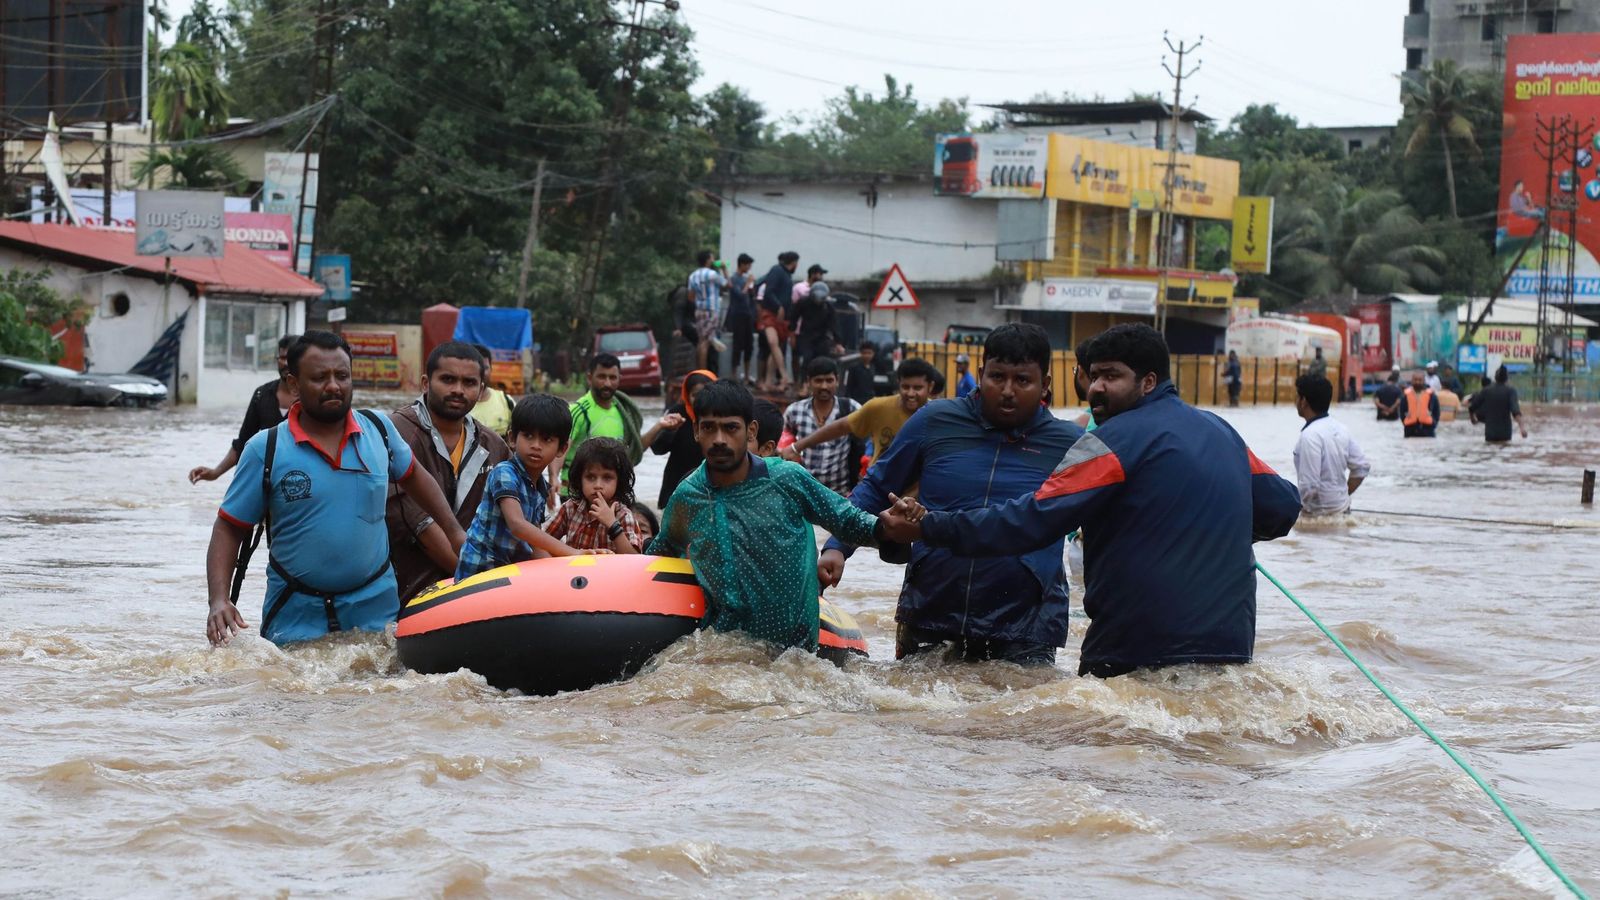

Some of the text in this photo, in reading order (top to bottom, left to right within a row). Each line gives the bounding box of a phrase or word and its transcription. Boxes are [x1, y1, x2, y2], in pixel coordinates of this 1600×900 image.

[1515, 76, 1551, 99] ഇനി
[224, 228, 289, 243] HONDA
[1062, 287, 1102, 298] MEDEV
[1489, 328, 1522, 342] FRESH
[1487, 344, 1538, 359] HIPS CENT
